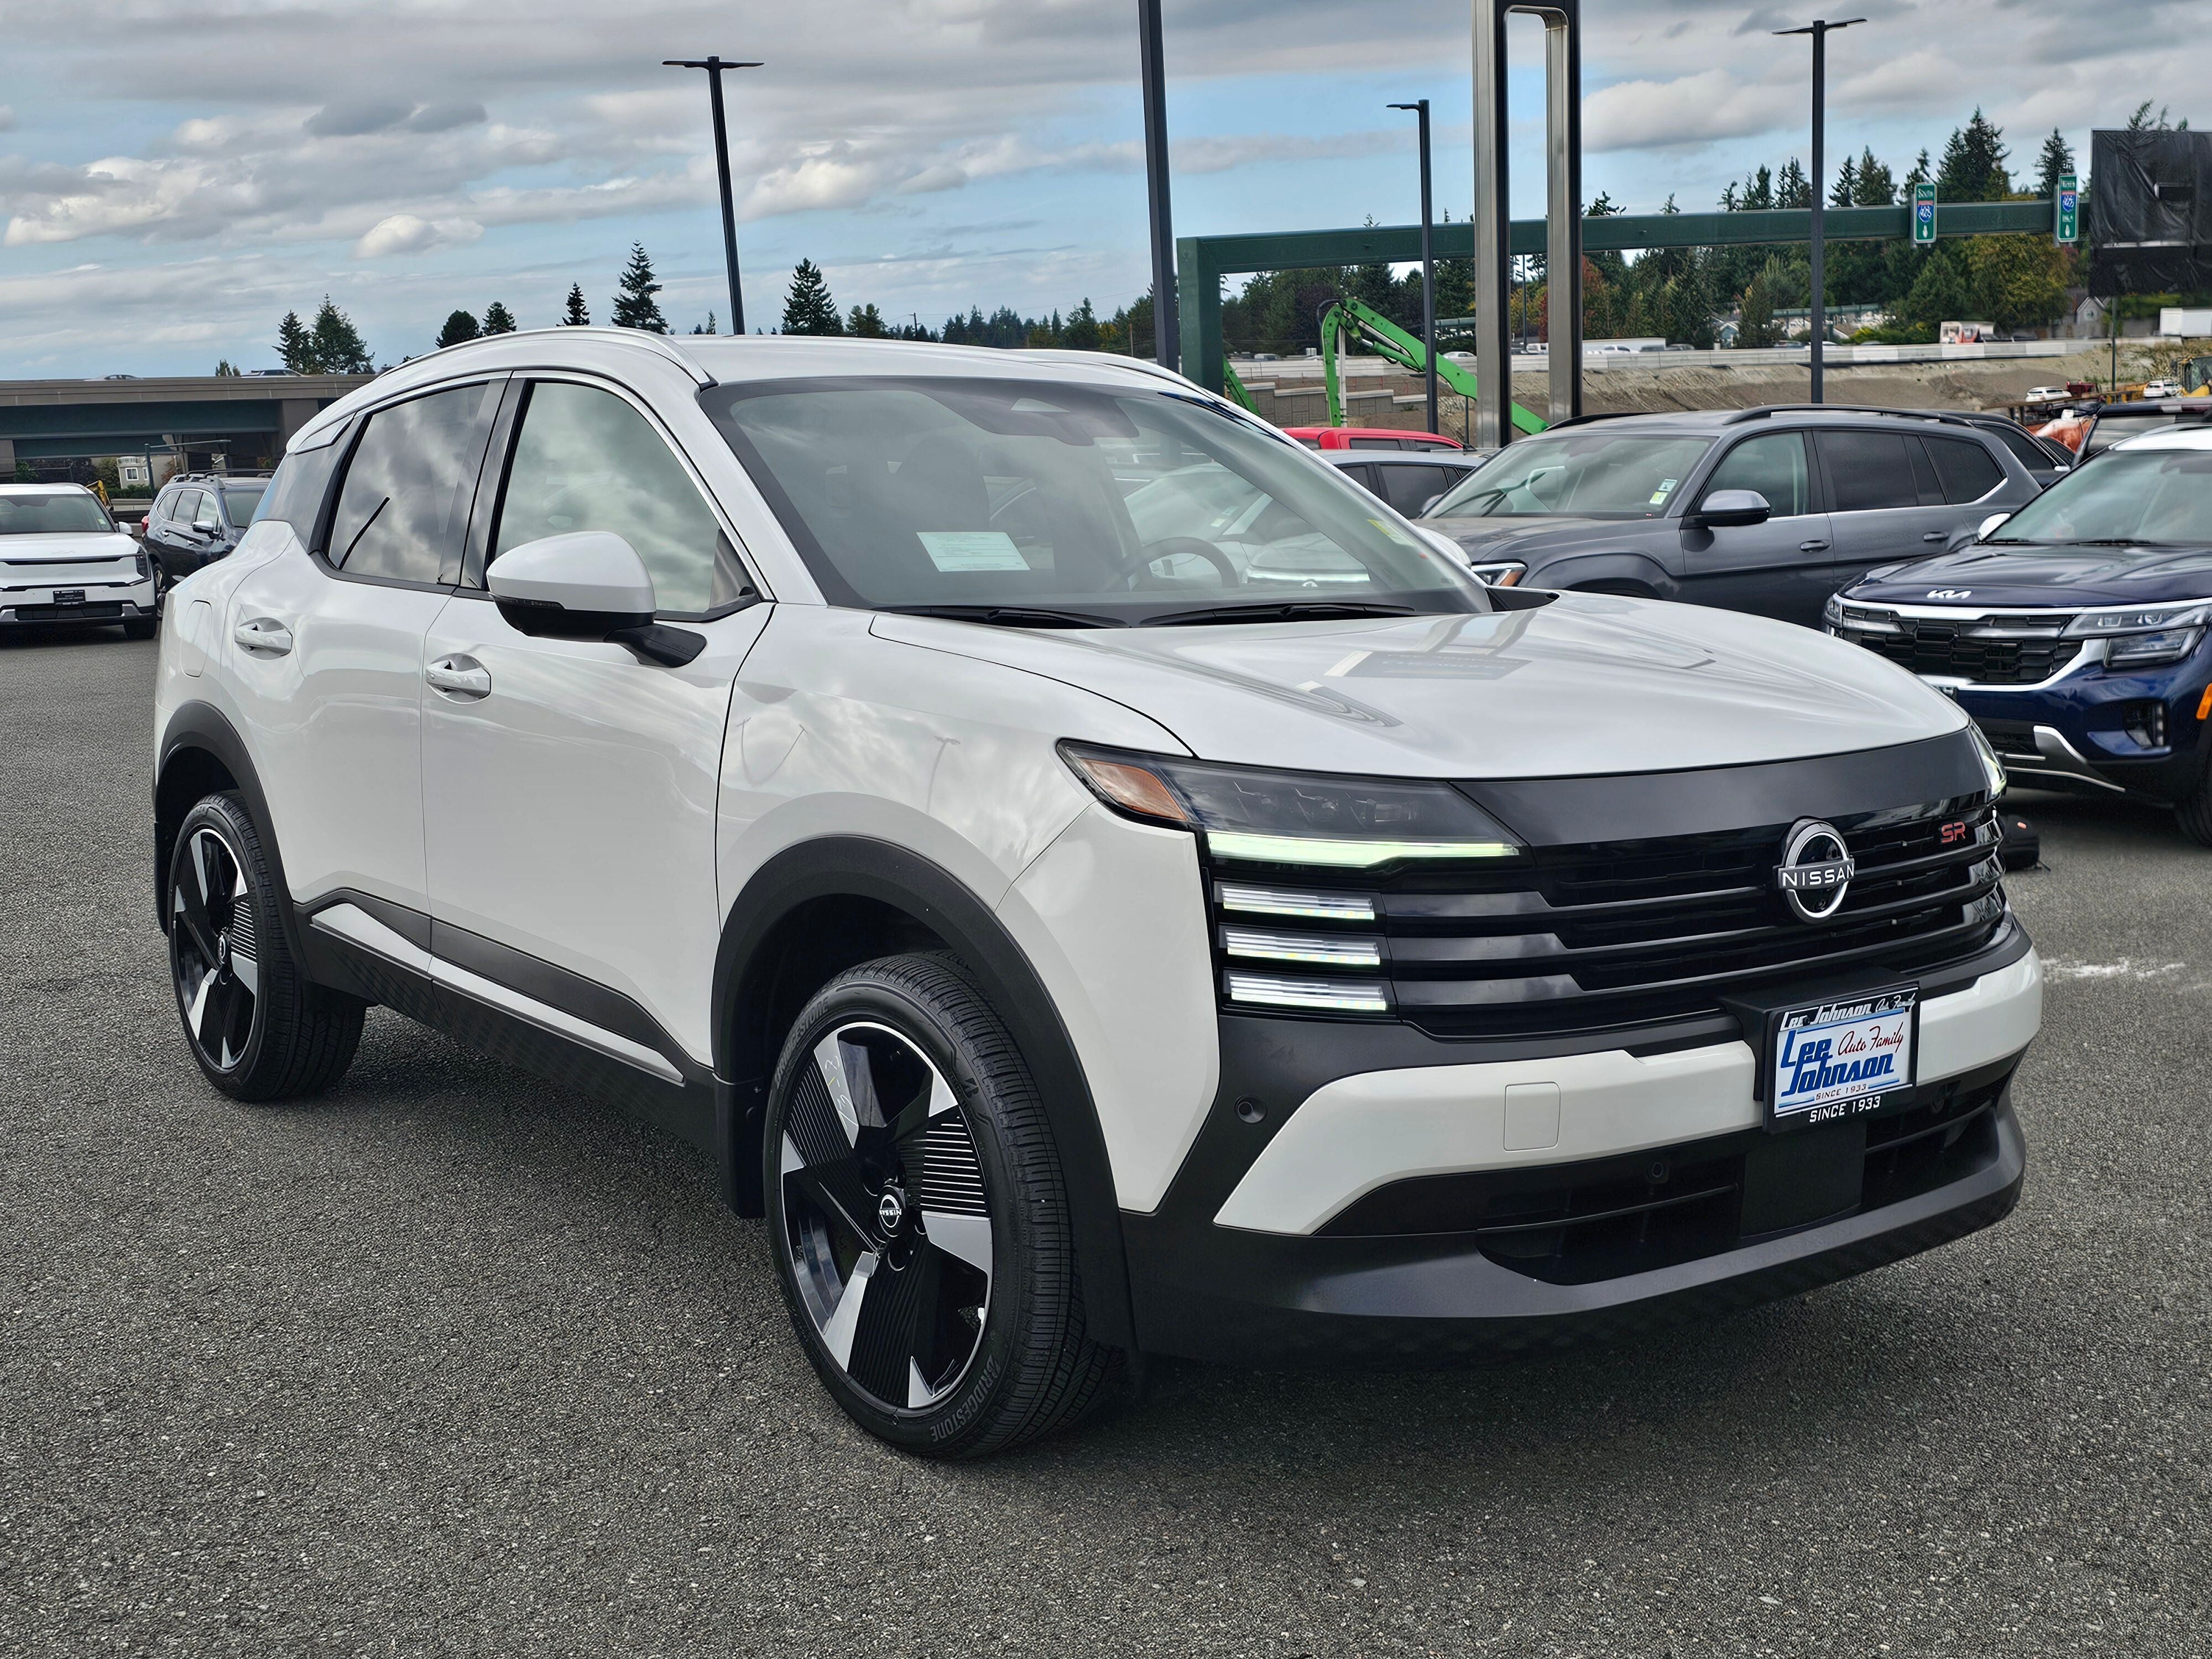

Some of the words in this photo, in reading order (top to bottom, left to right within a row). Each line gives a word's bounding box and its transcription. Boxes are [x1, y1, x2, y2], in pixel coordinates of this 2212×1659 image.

[1941, 822, 1966, 843] SR
[1782, 863, 1855, 886] NISSAN
[1810, 1003, 1872, 1025] Johnson
[775, 996, 828, 1089] BRIDGESTONE
[1780, 1030, 1833, 1068] Lee
[1838, 1030, 1866, 1056] Auto
[1869, 1021, 1903, 1053] Family
[1781, 1053, 1894, 1097] Johnson
[1815, 1088, 1841, 1100] SINCE
[1846, 1083, 1867, 1094] 1933
[1809, 1103, 1846, 1123] SINCE
[1853, 1095, 1881, 1113] 1933
[930, 1354, 1000, 1442] BRIDGESTONE
